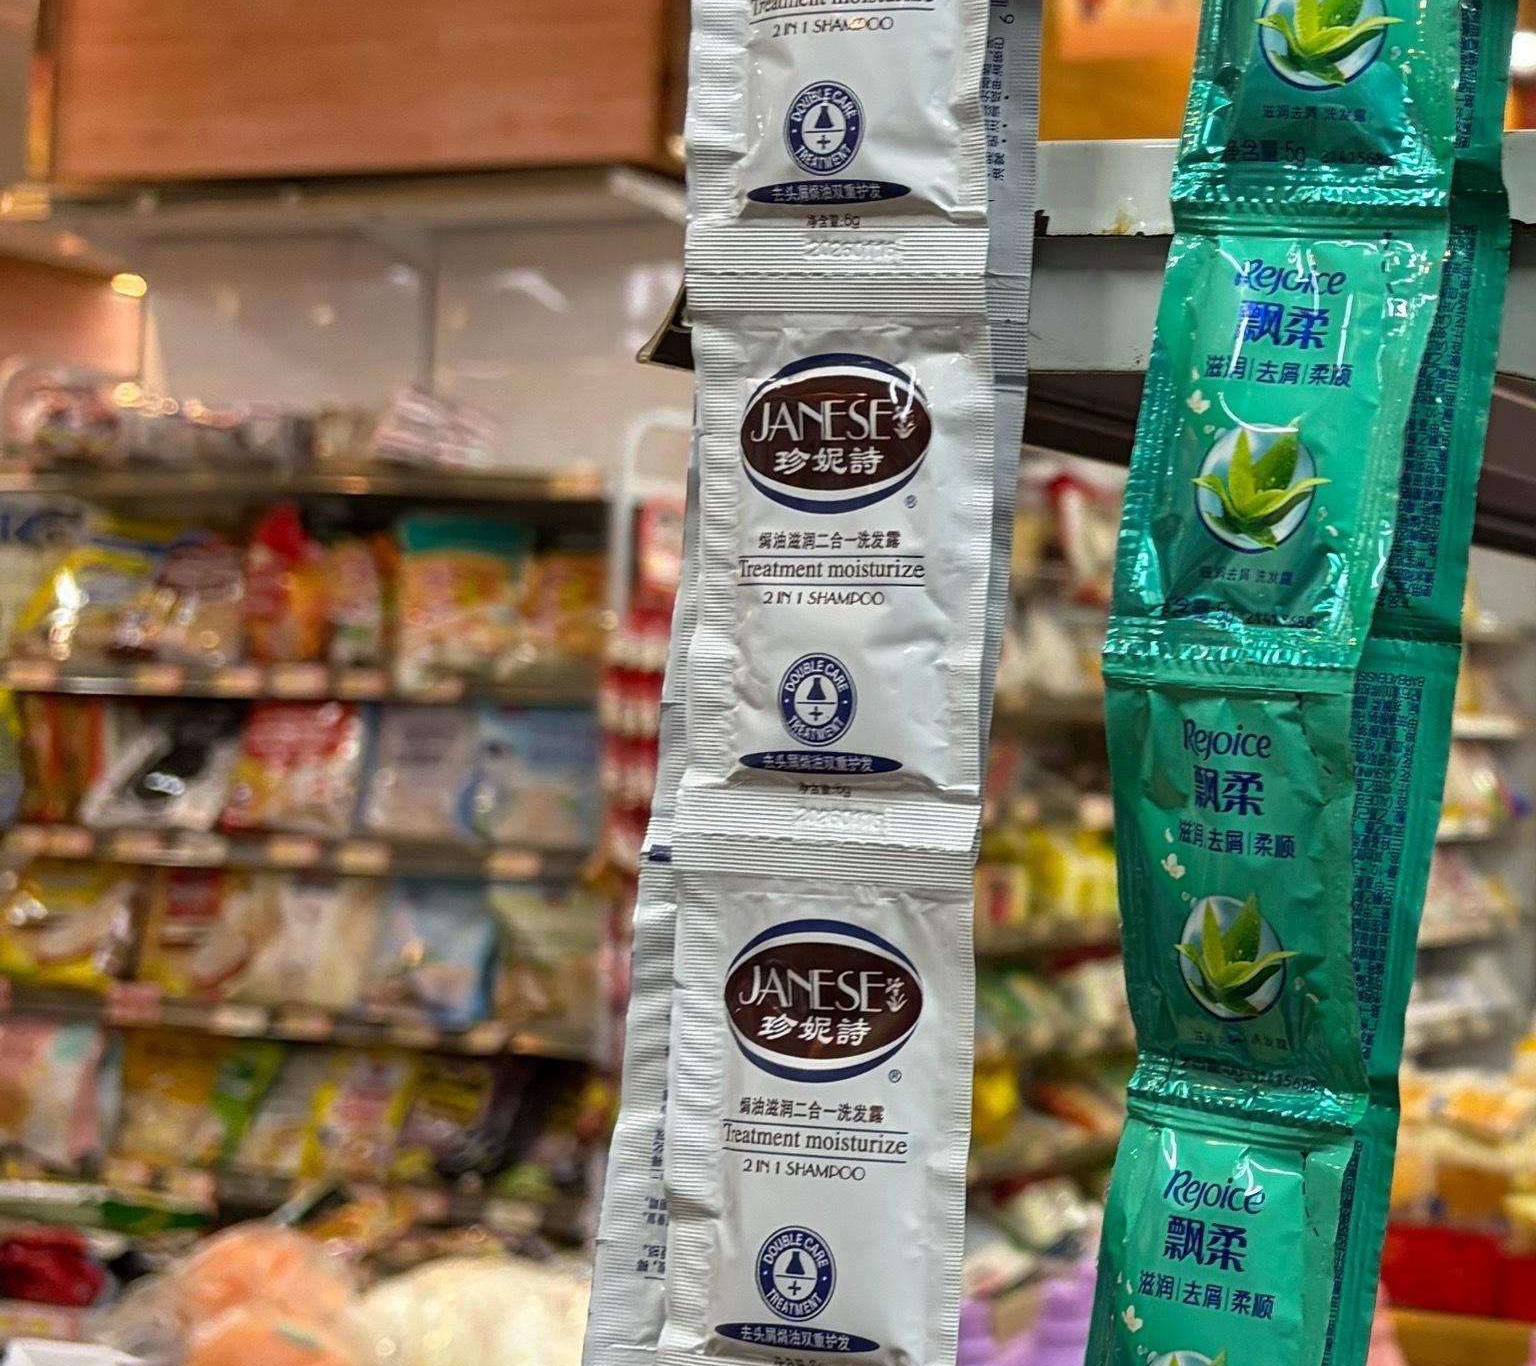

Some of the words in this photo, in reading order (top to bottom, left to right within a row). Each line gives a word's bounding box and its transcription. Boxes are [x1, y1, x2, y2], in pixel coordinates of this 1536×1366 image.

[750, 398, 894, 443] JANESE
[773, 448, 884, 476] 珍妮詩
[739, 558, 824, 580] Treatment
[828, 558, 926, 579] moisturize
[763, 592, 773, 606] 2
[776, 592, 791, 606] IN
[807, 591, 885, 606] SHAMPOO
[738, 963, 885, 1013] JANESE
[758, 1012, 873, 1047] 珍妮詩
[722, 1123, 801, 1150] Treatment
[806, 1130, 908, 1156] moisturize
[742, 1158, 752, 1174] 2
[755, 1159, 770, 1175] IN
[784, 1160, 866, 1182] SHAMPOO
[1162, 1168, 1267, 1215] Rejoice
[1161, 1213, 1248, 1274] 飘柔
